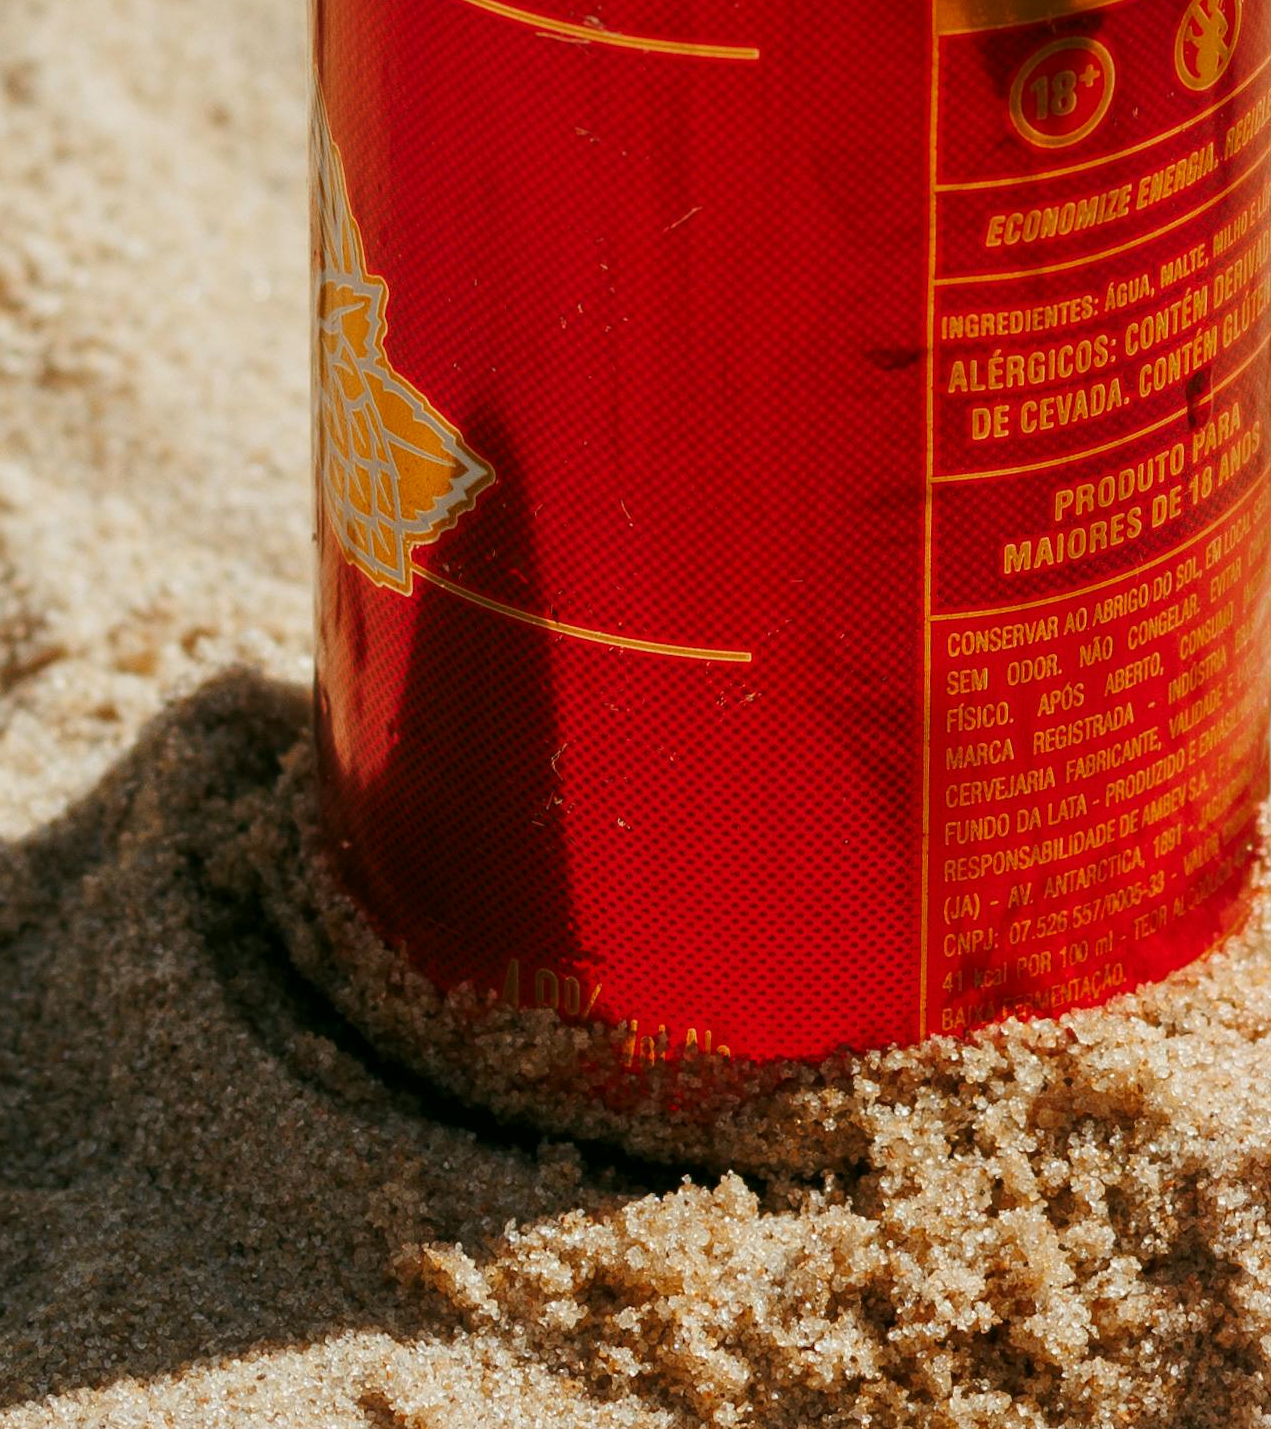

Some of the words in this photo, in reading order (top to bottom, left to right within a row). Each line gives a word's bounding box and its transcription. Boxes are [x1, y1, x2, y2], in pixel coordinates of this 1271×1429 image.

[985, 183, 1133, 248] ECONOMIZE
[1136, 141, 1219, 212] ENERGIA.
[940, 294, 1100, 341] INGREDIENTES:
[1103, 273, 1156, 312] ÁGUA,
[1159, 242, 1211, 289] MALTE,
[1212, 207, 1249, 259] MILHO
[947, 334, 1118, 395] ALÉRGICOS:
[1125, 285, 1208, 357] CONTÉM
[971, 404, 1010, 441] DE
[1019, 377, 1131, 435] CEVADA.
[1138, 330, 1219, 399] CONTÉM
[1003, 505, 1143, 575] MAIORES
[1151, 484, 1183, 530] DE
[1189, 465, 1214, 507] 18
[1217, 421, 1261, 487] ANOS
[1053, 442, 1186, 522] PRODUTO
[1191, 401, 1241, 464] PARA
[945, 666, 989, 697] SEM
[1007, 653, 1063, 687] ODOR.
[1079, 634, 1115, 669] NÃO
[1126, 592, 1202, 651] CONGELAR.
[946, 615, 1060, 659] CONSERVAR
[1063, 606, 1089, 637] AO
[1091, 582, 1150, 629] ABRIGO
[1151, 569, 1173, 602] DO
[1174, 558, 1204, 594] SOL,
[946, 700, 1015, 734] FÍSICO.
[1037, 682, 1085, 717] APÓS
[1104, 651, 1165, 698] ABERTO,
[946, 737, 1015, 771] MARCA
[1033, 701, 1135, 756] REGISTRADA
[945, 764, 1056, 809] CERVEJARIA
[1065, 725, 1163, 784] FABRICANTE,
[1168, 682, 1224, 740] VALIDADE
[945, 806, 1011, 846] FUNDO
[1016, 803, 1042, 834] DA
[1047, 793, 1088, 826] LATA
[1105, 746, 1185, 809] PRODUZIDO
[943, 891, 980, 926] (JA)
[1043, 845, 1146, 902] ANTARCTICA,
[944, 822, 1116, 885] RESPONSABILIDADE
[1119, 812, 1139, 841] DE
[1141, 791, 1187, 834] AMBEV
[943, 926, 1000, 959] CNPJ:
[1016, 950, 1053, 980] POR
[1059, 939, 1091, 969] 100
[1094, 930, 1114, 959] ml
